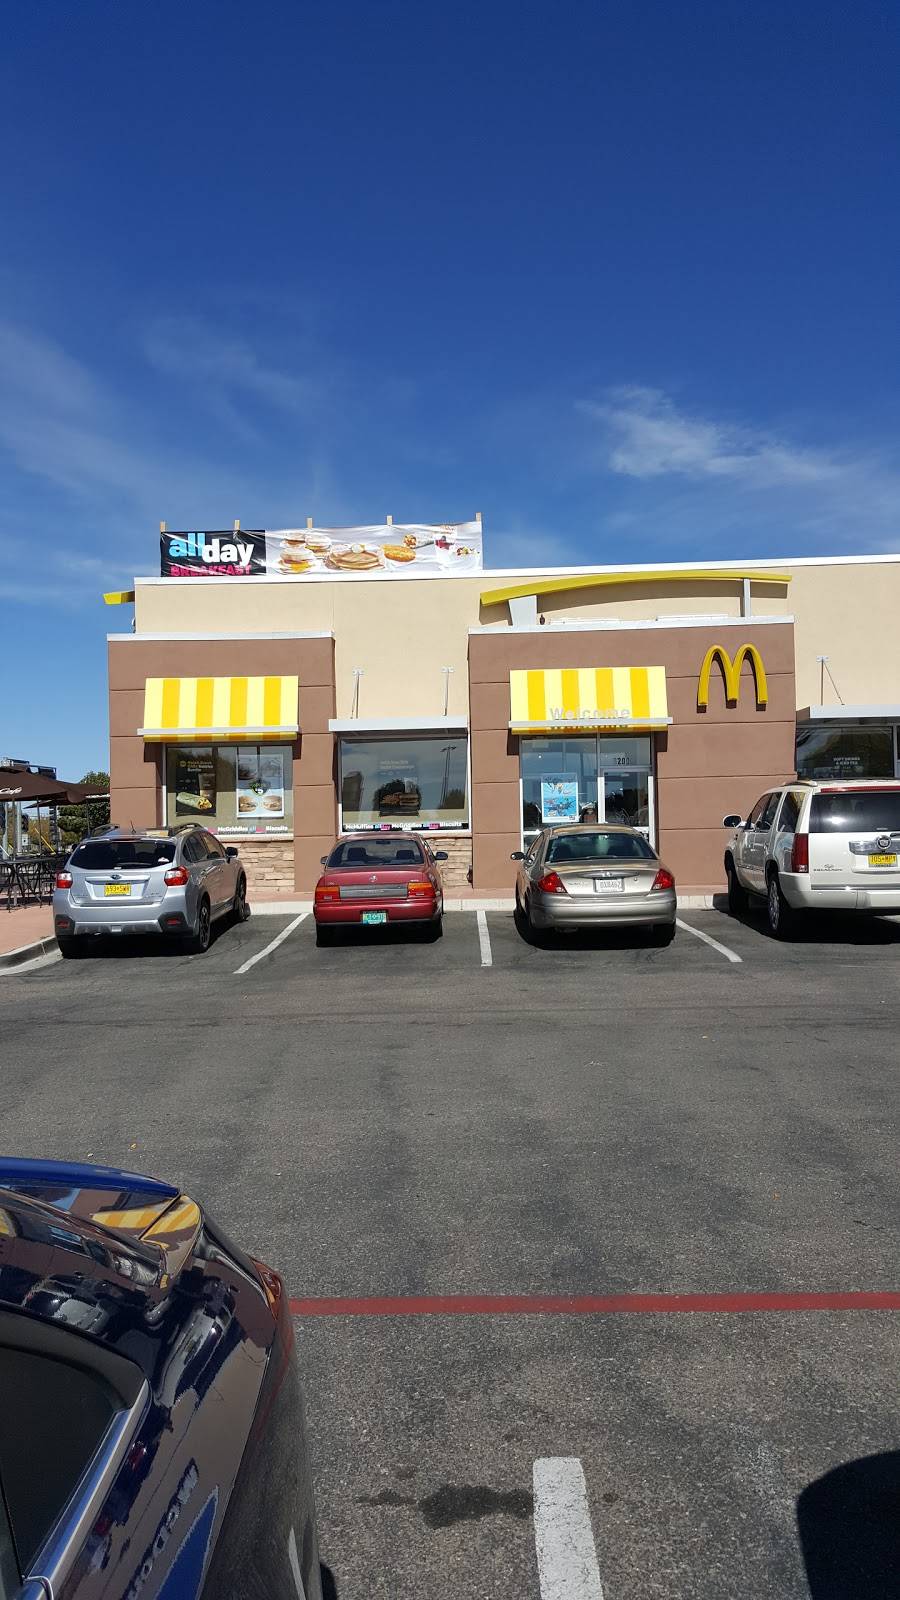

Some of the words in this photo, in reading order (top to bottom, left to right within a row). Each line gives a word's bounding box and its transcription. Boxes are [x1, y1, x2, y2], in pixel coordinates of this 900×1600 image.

[169, 533, 205, 557] all
[202, 539, 254, 567] day
[550, 706, 631, 720] Welcome
